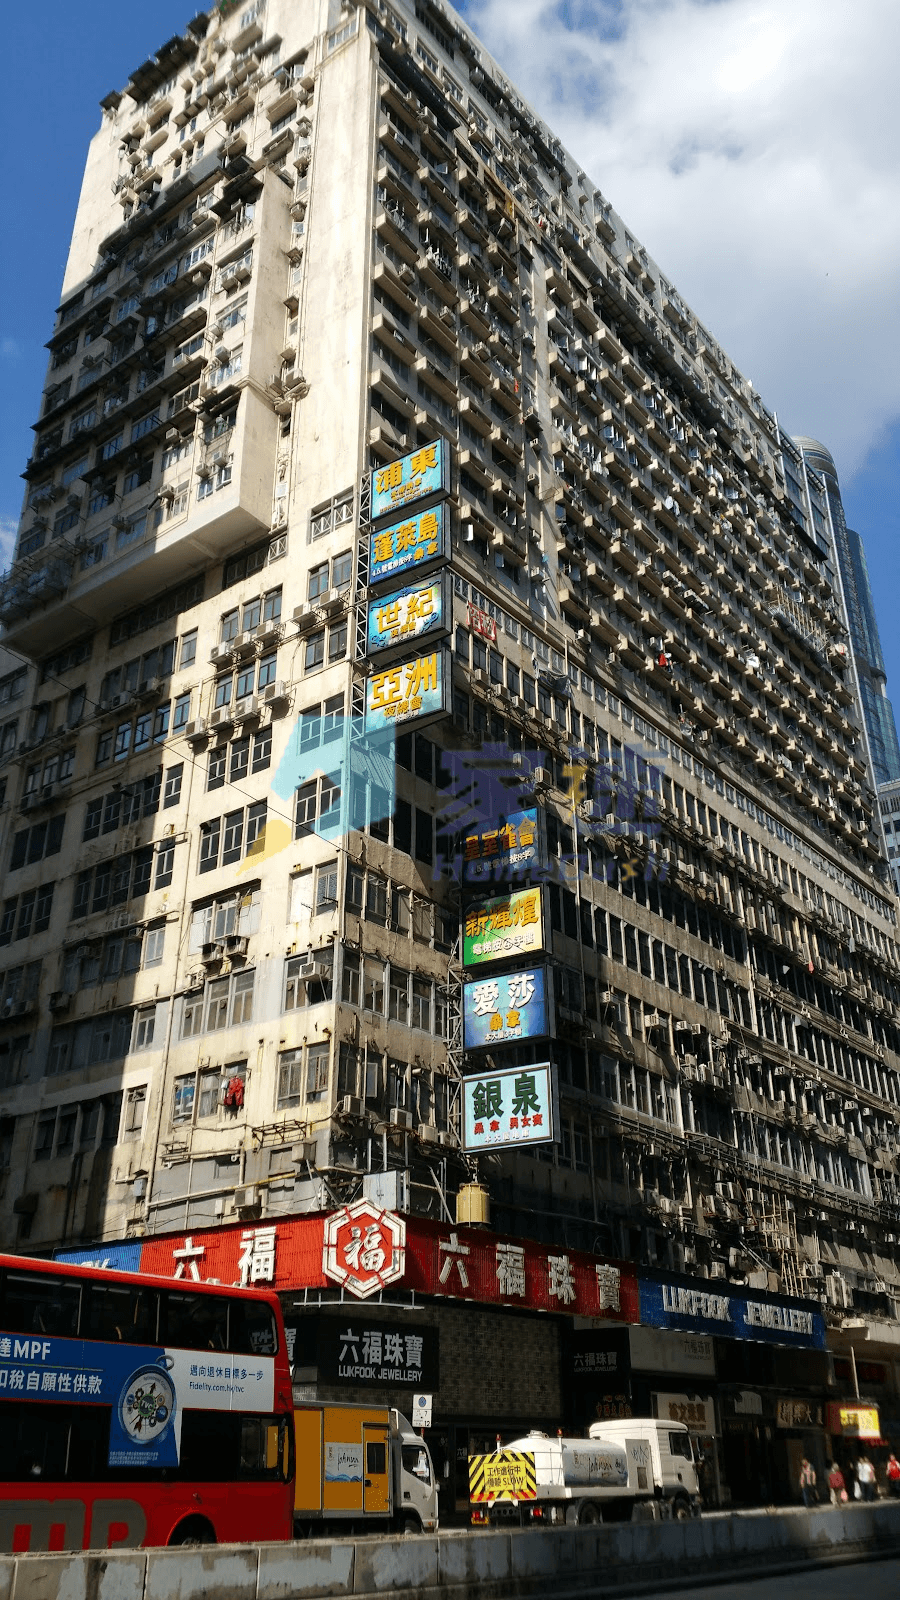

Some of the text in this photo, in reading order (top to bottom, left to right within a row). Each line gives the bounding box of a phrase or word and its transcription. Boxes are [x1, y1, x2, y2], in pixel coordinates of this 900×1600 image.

[375, 443, 439, 495] 浦東
[373, 512, 439, 565] 蓬萊島
[376, 587, 434, 635] 世紀
[390, 621, 417, 639] 夜總會
[370, 652, 438, 711] 亞洲
[383, 695, 423, 719] 夜總會
[465, 895, 540, 939] 新輝煌
[472, 973, 536, 1017] 愛莎
[489, 1010, 521, 1032] 桑拿
[471, 1072, 542, 1121] 銀泉
[509, 1113, 544, 1131] 男女賓
[172, 1226, 277, 1287] 六福
[343, 1223, 385, 1273] 福
[438, 1232, 622, 1313] 六福珠寶
[661, 1284, 814, 1335] LUKFOOK JEWELLERY
[0, 1337, 52, 1361] 達MPF
[338, 1328, 424, 1368] 六福珠寶
[573, 1351, 618, 1367] 六福珠寶
[189, 1364, 264, 1381] 邁向退休目標多一步
[189, 1381, 245, 1393] Fidelity.com.hk/tvc
[338, 1365, 424, 1382] LUKFOOK JEWELLERY
[502, 1475, 524, 1486] SLOW
